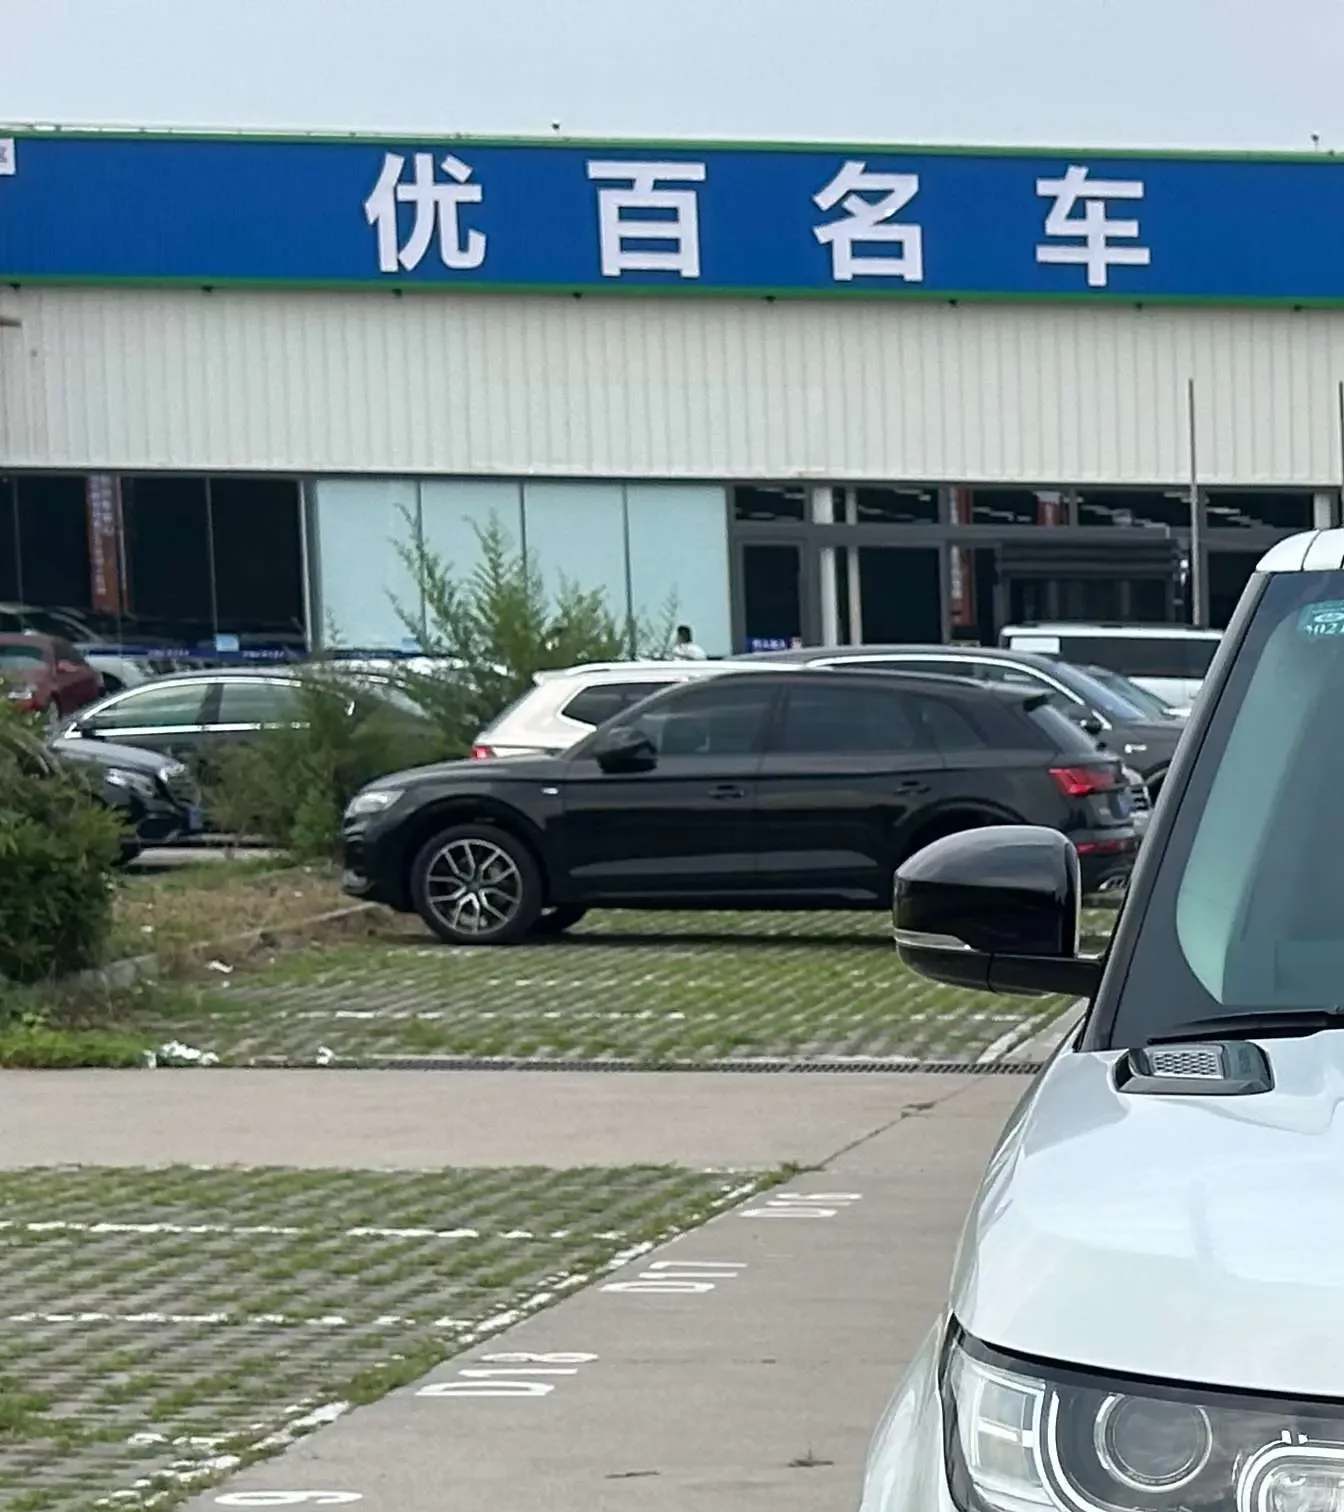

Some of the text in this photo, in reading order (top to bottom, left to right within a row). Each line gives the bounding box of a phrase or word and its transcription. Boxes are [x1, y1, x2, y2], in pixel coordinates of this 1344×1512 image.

[365, 152, 1151, 286] 优百名车
[599, 1260, 748, 1293] D17
[414, 1351, 599, 1396] D18
